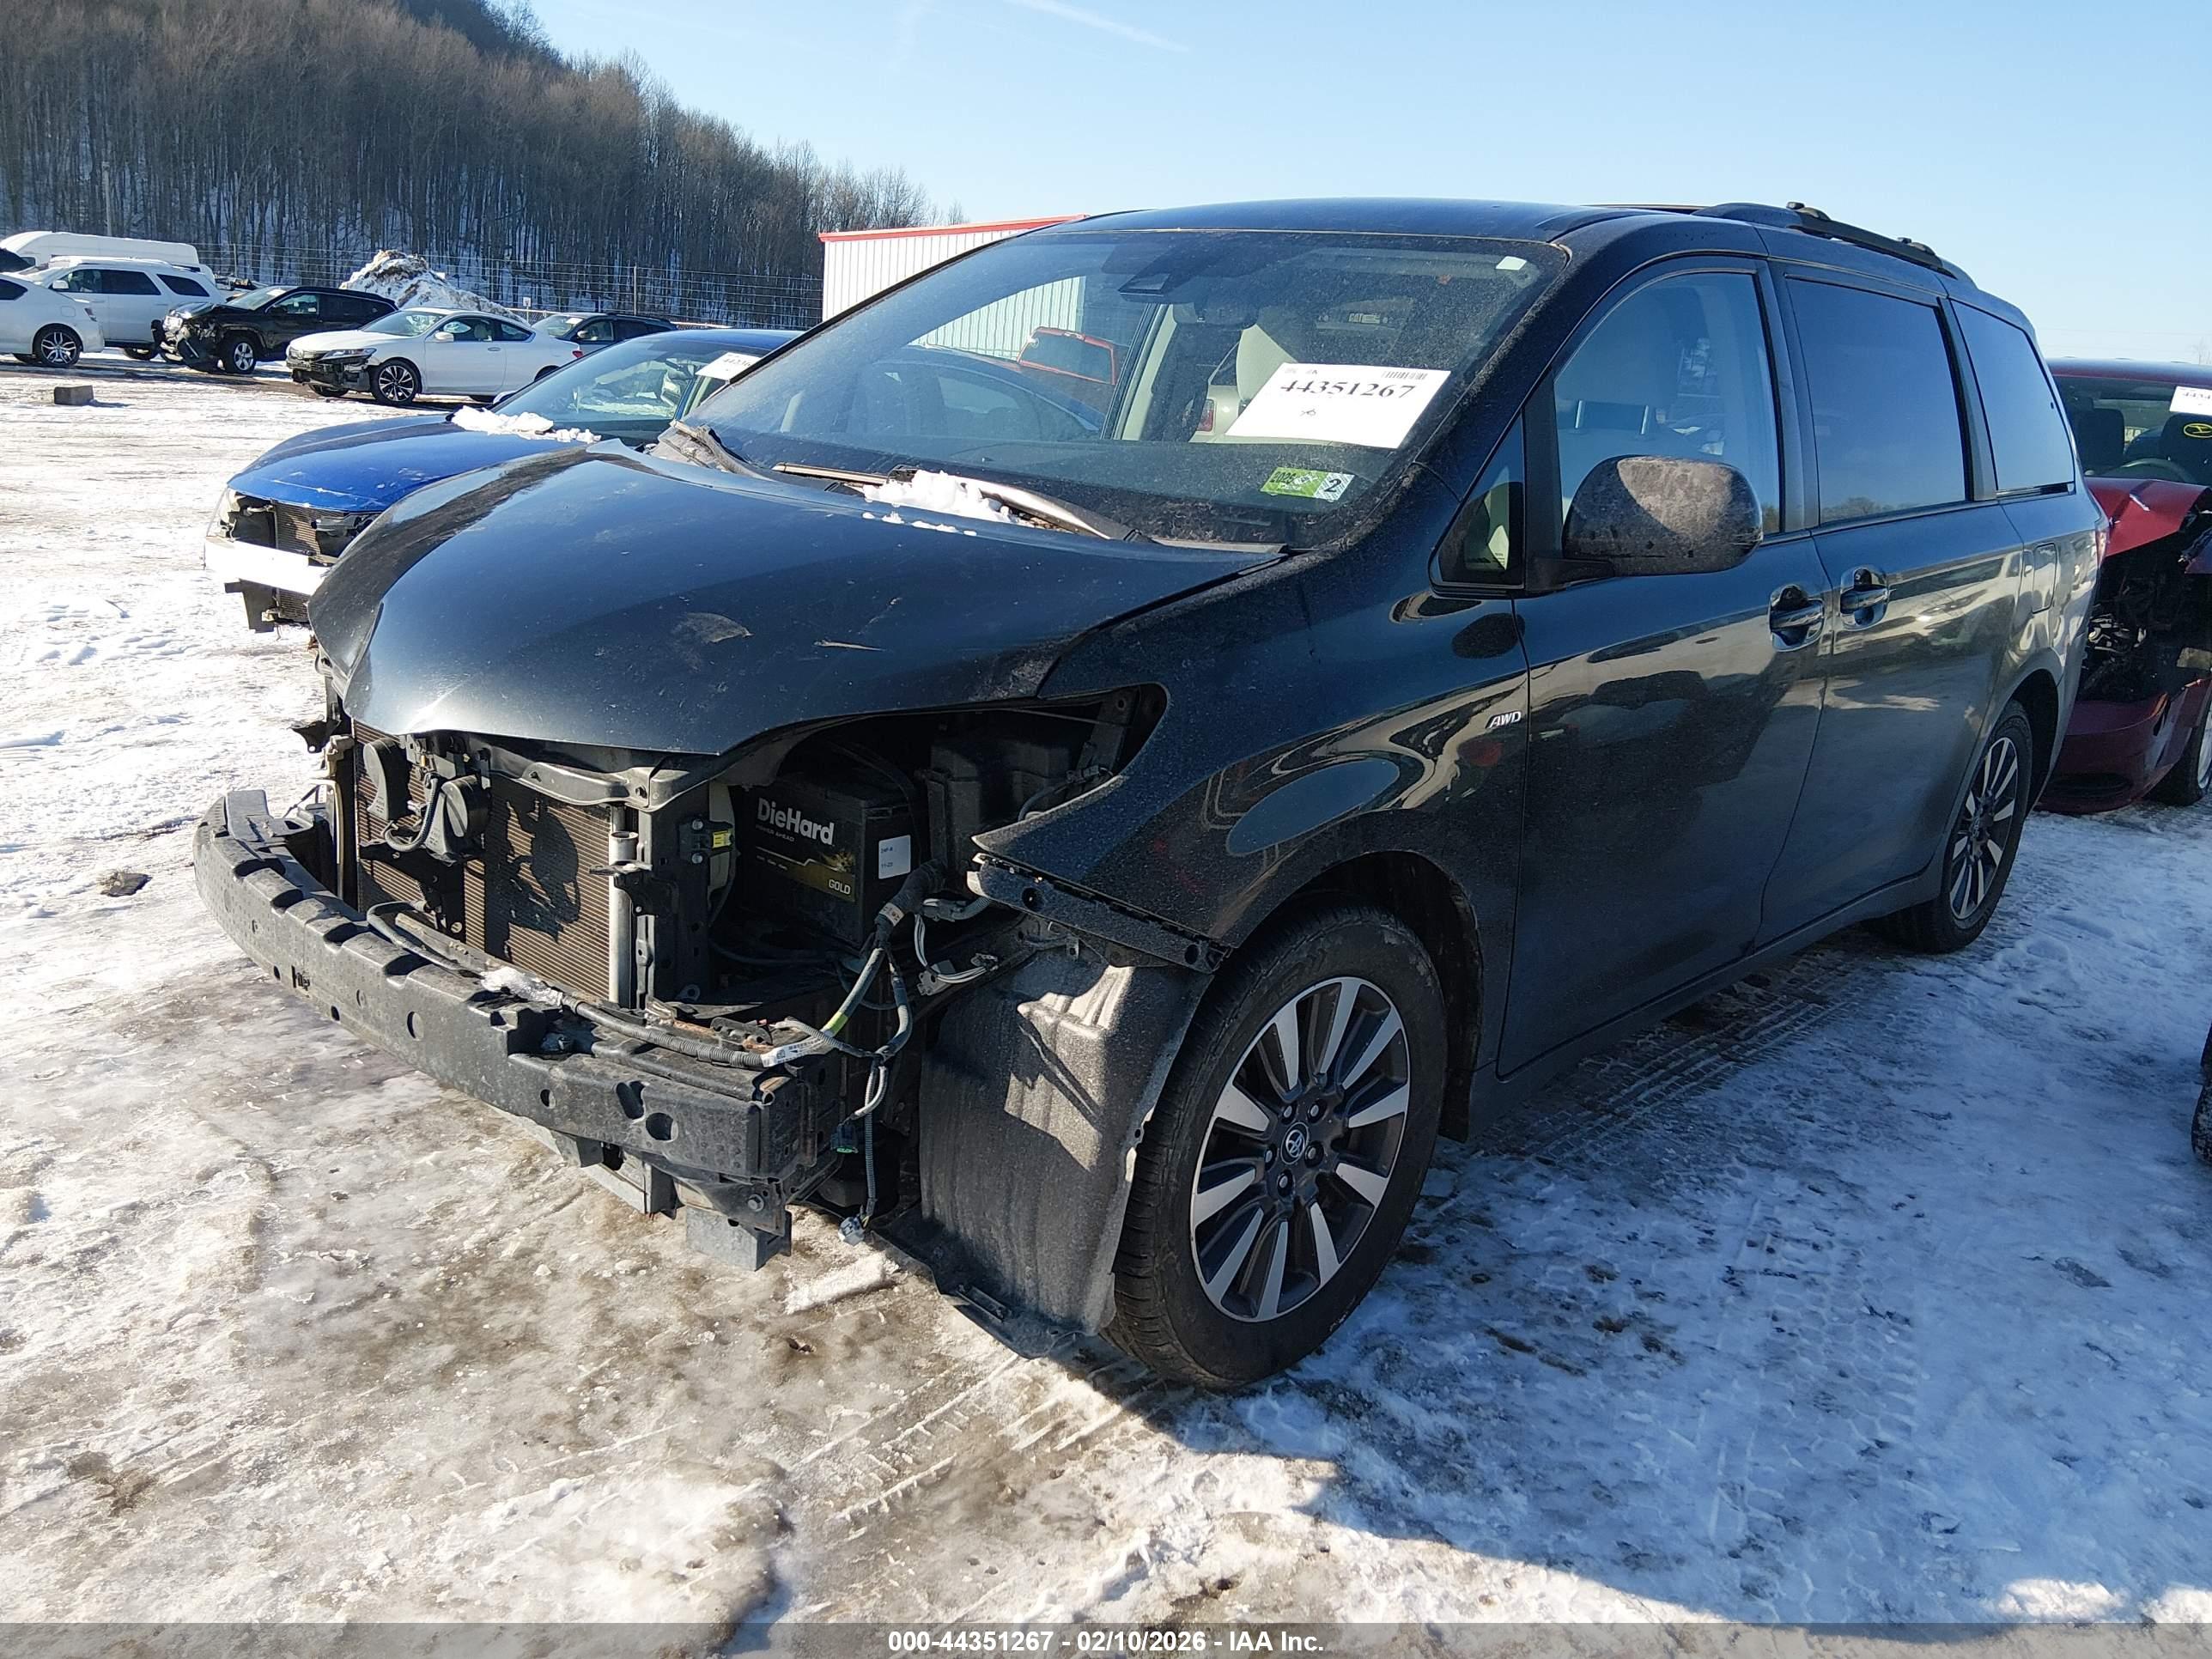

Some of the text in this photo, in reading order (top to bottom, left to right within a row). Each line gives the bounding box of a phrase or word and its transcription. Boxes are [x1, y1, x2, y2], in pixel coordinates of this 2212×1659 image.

[1280, 380, 1416, 398] 44351267
[1324, 478, 1341, 493] 2
[1488, 711, 1522, 728] AWD
[757, 798, 834, 844] DieHard
[829, 878, 850, 895] GOLD
